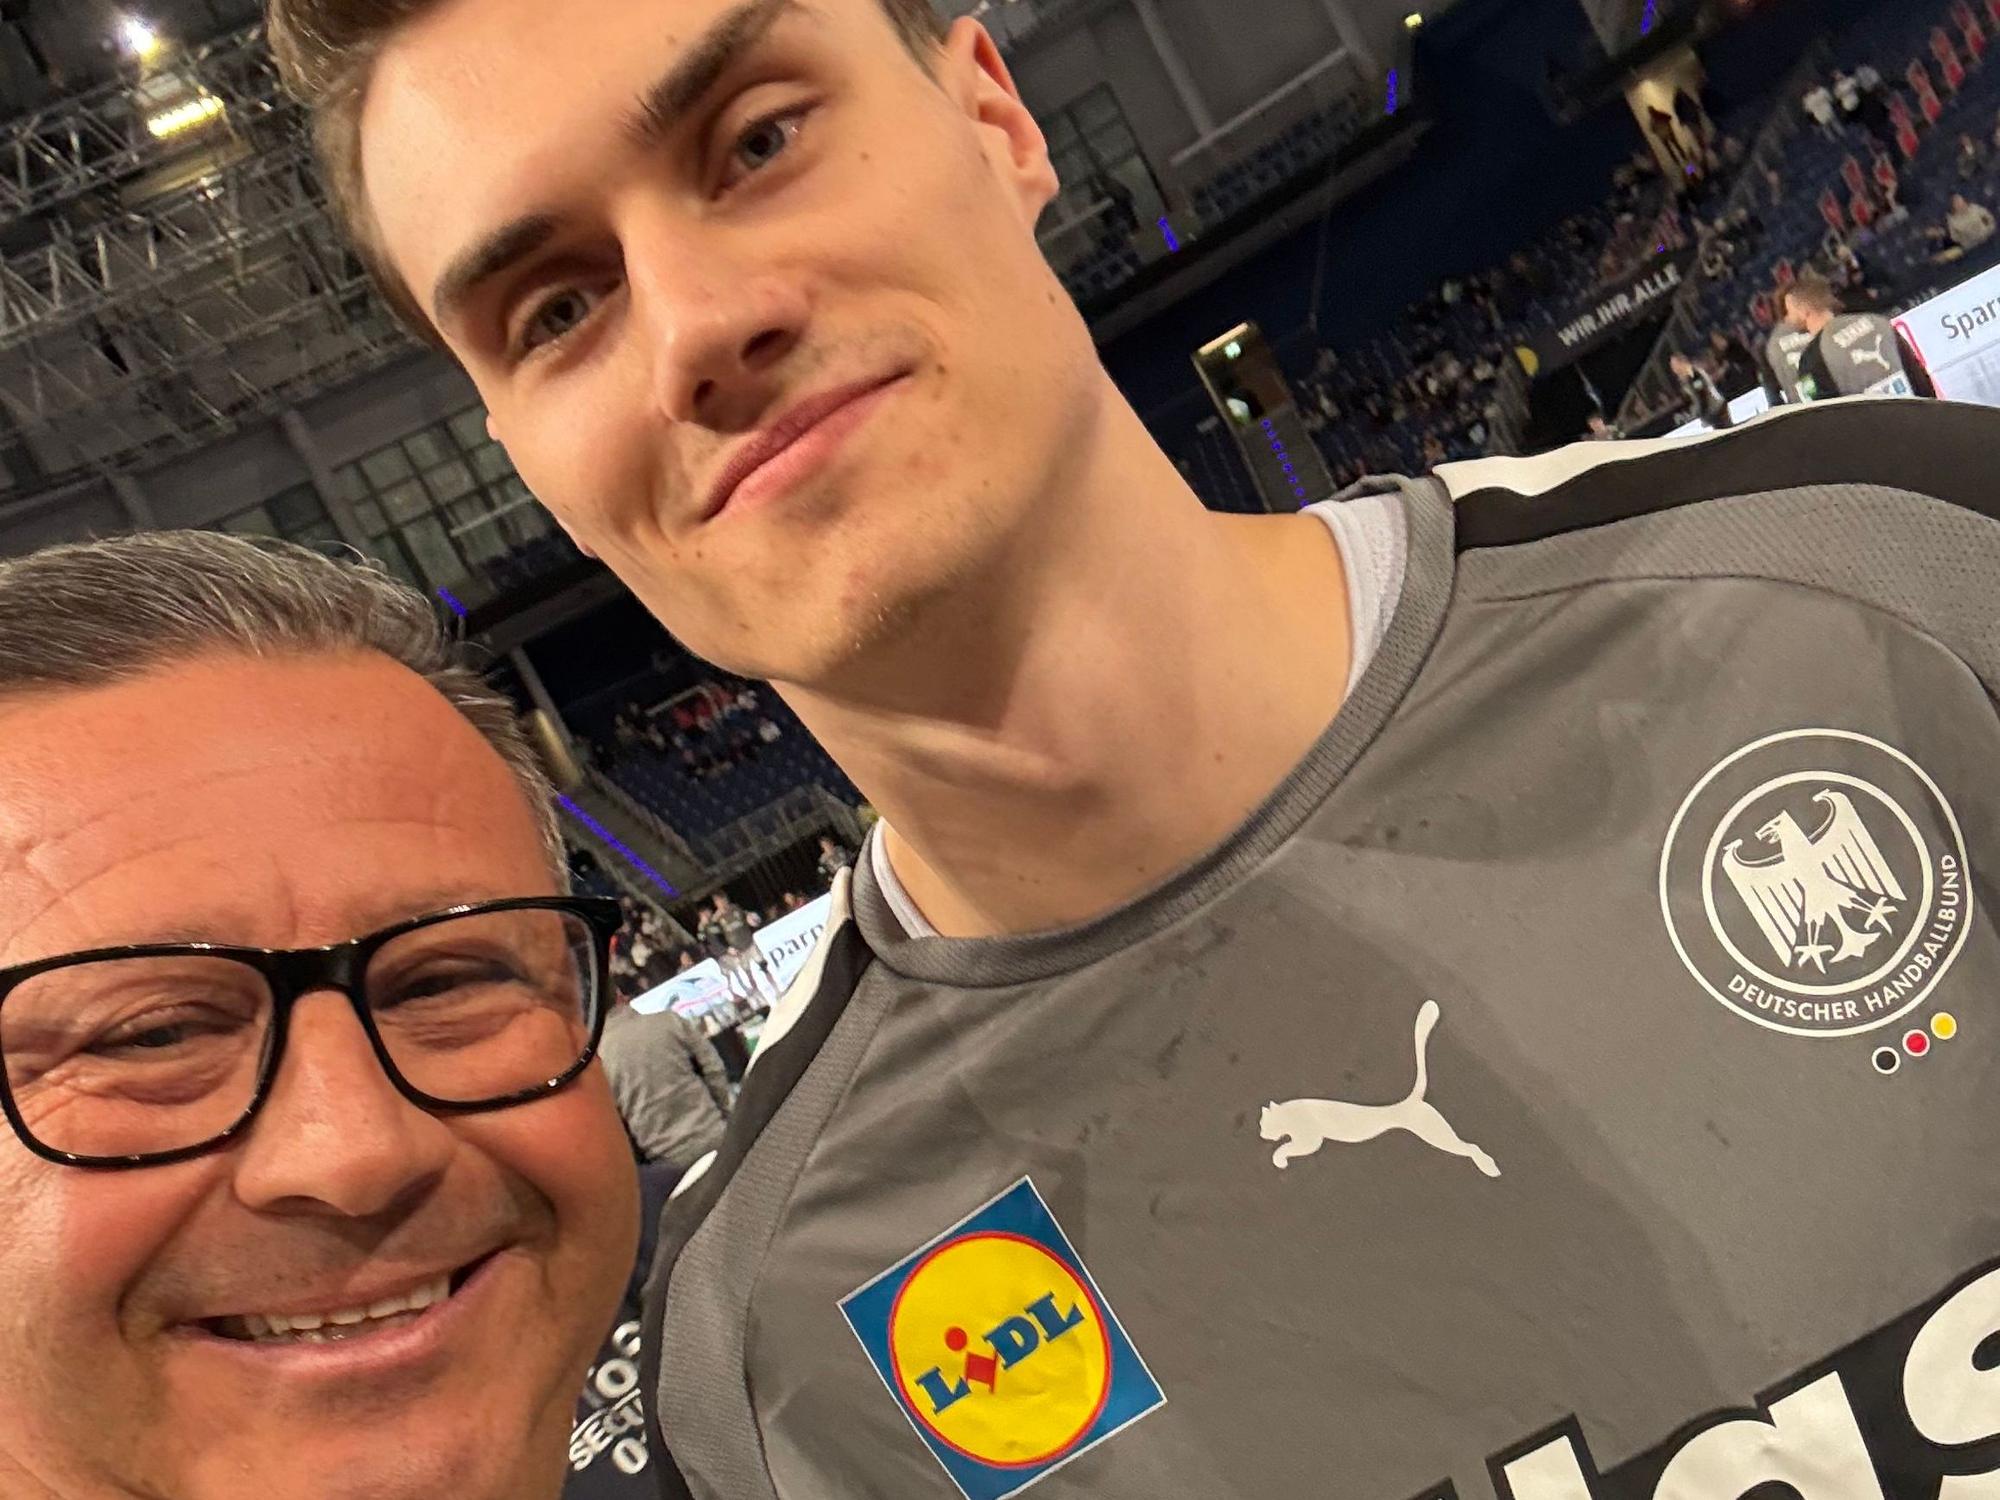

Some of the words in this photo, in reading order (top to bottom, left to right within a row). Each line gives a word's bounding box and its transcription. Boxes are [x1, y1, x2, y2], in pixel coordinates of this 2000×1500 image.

[1941, 297, 2000, 339] Spar
[1727, 973, 1861, 1021] DEUTSCHER
[1866, 853, 1961, 1013] HANDBALLBUND
